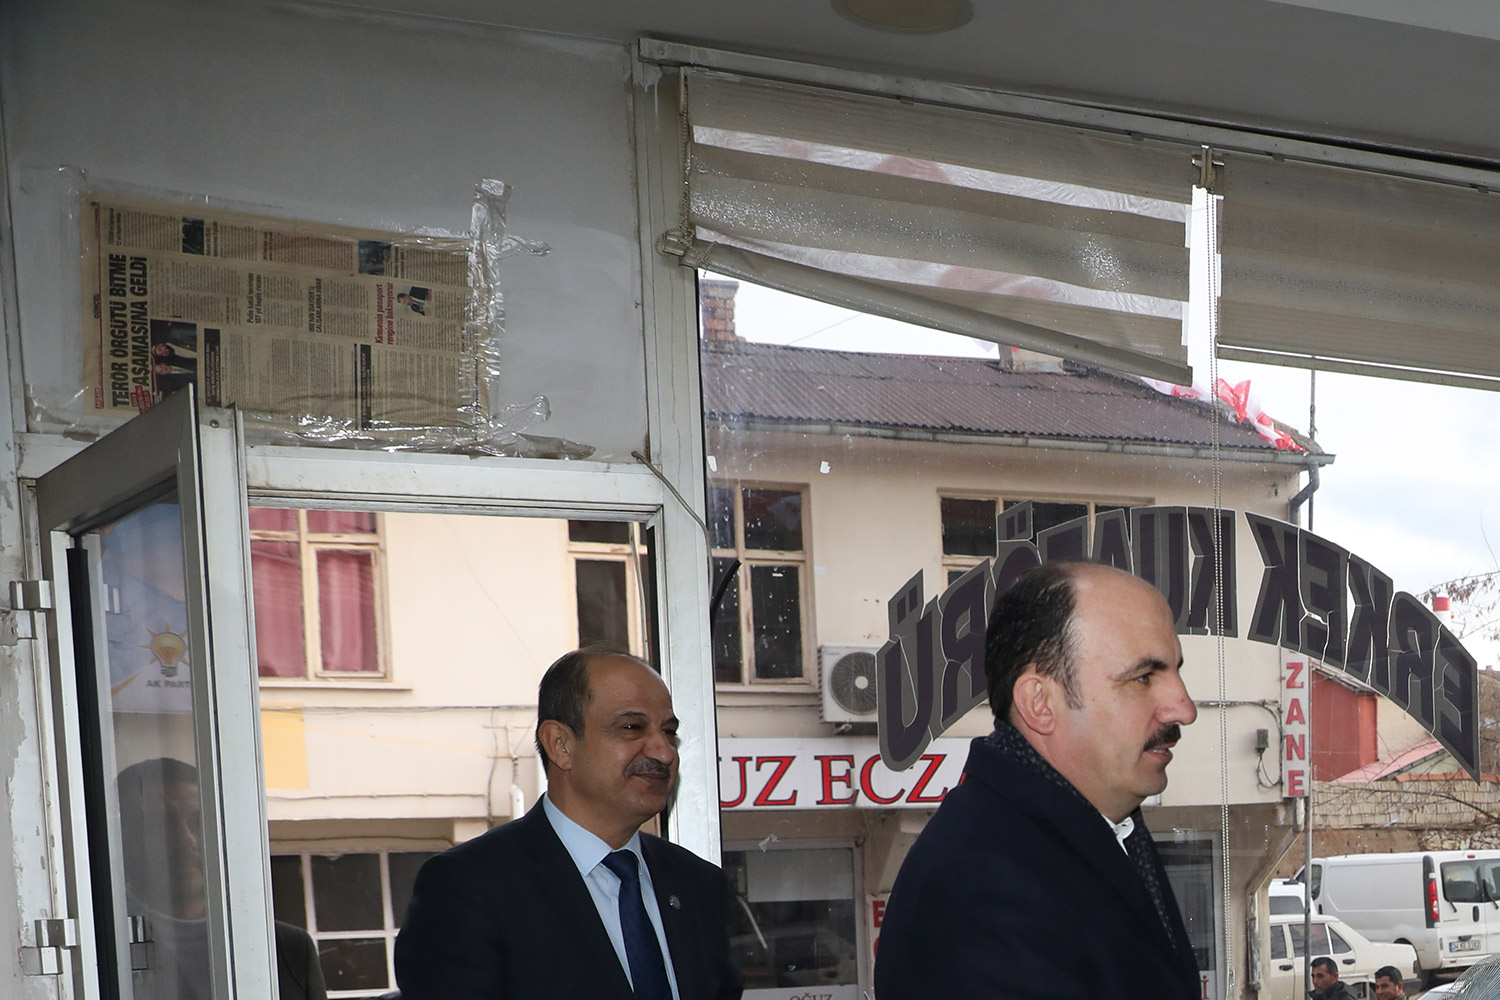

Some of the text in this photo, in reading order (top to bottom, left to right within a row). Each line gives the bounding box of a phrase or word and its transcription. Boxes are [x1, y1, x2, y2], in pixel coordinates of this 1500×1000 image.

[107, 300, 128, 358] ÖRGÜTÜ
[375, 284, 385, 344] Kimsenin pasaport
[385, 282, 395, 345] rengine bakmıyoruz
[129, 300, 149, 387] AŞAMASINA
[110, 362, 130, 407] TERÖR
[164, 680, 191, 688] PART
[720, 753, 967, 808] UZ ECZ
